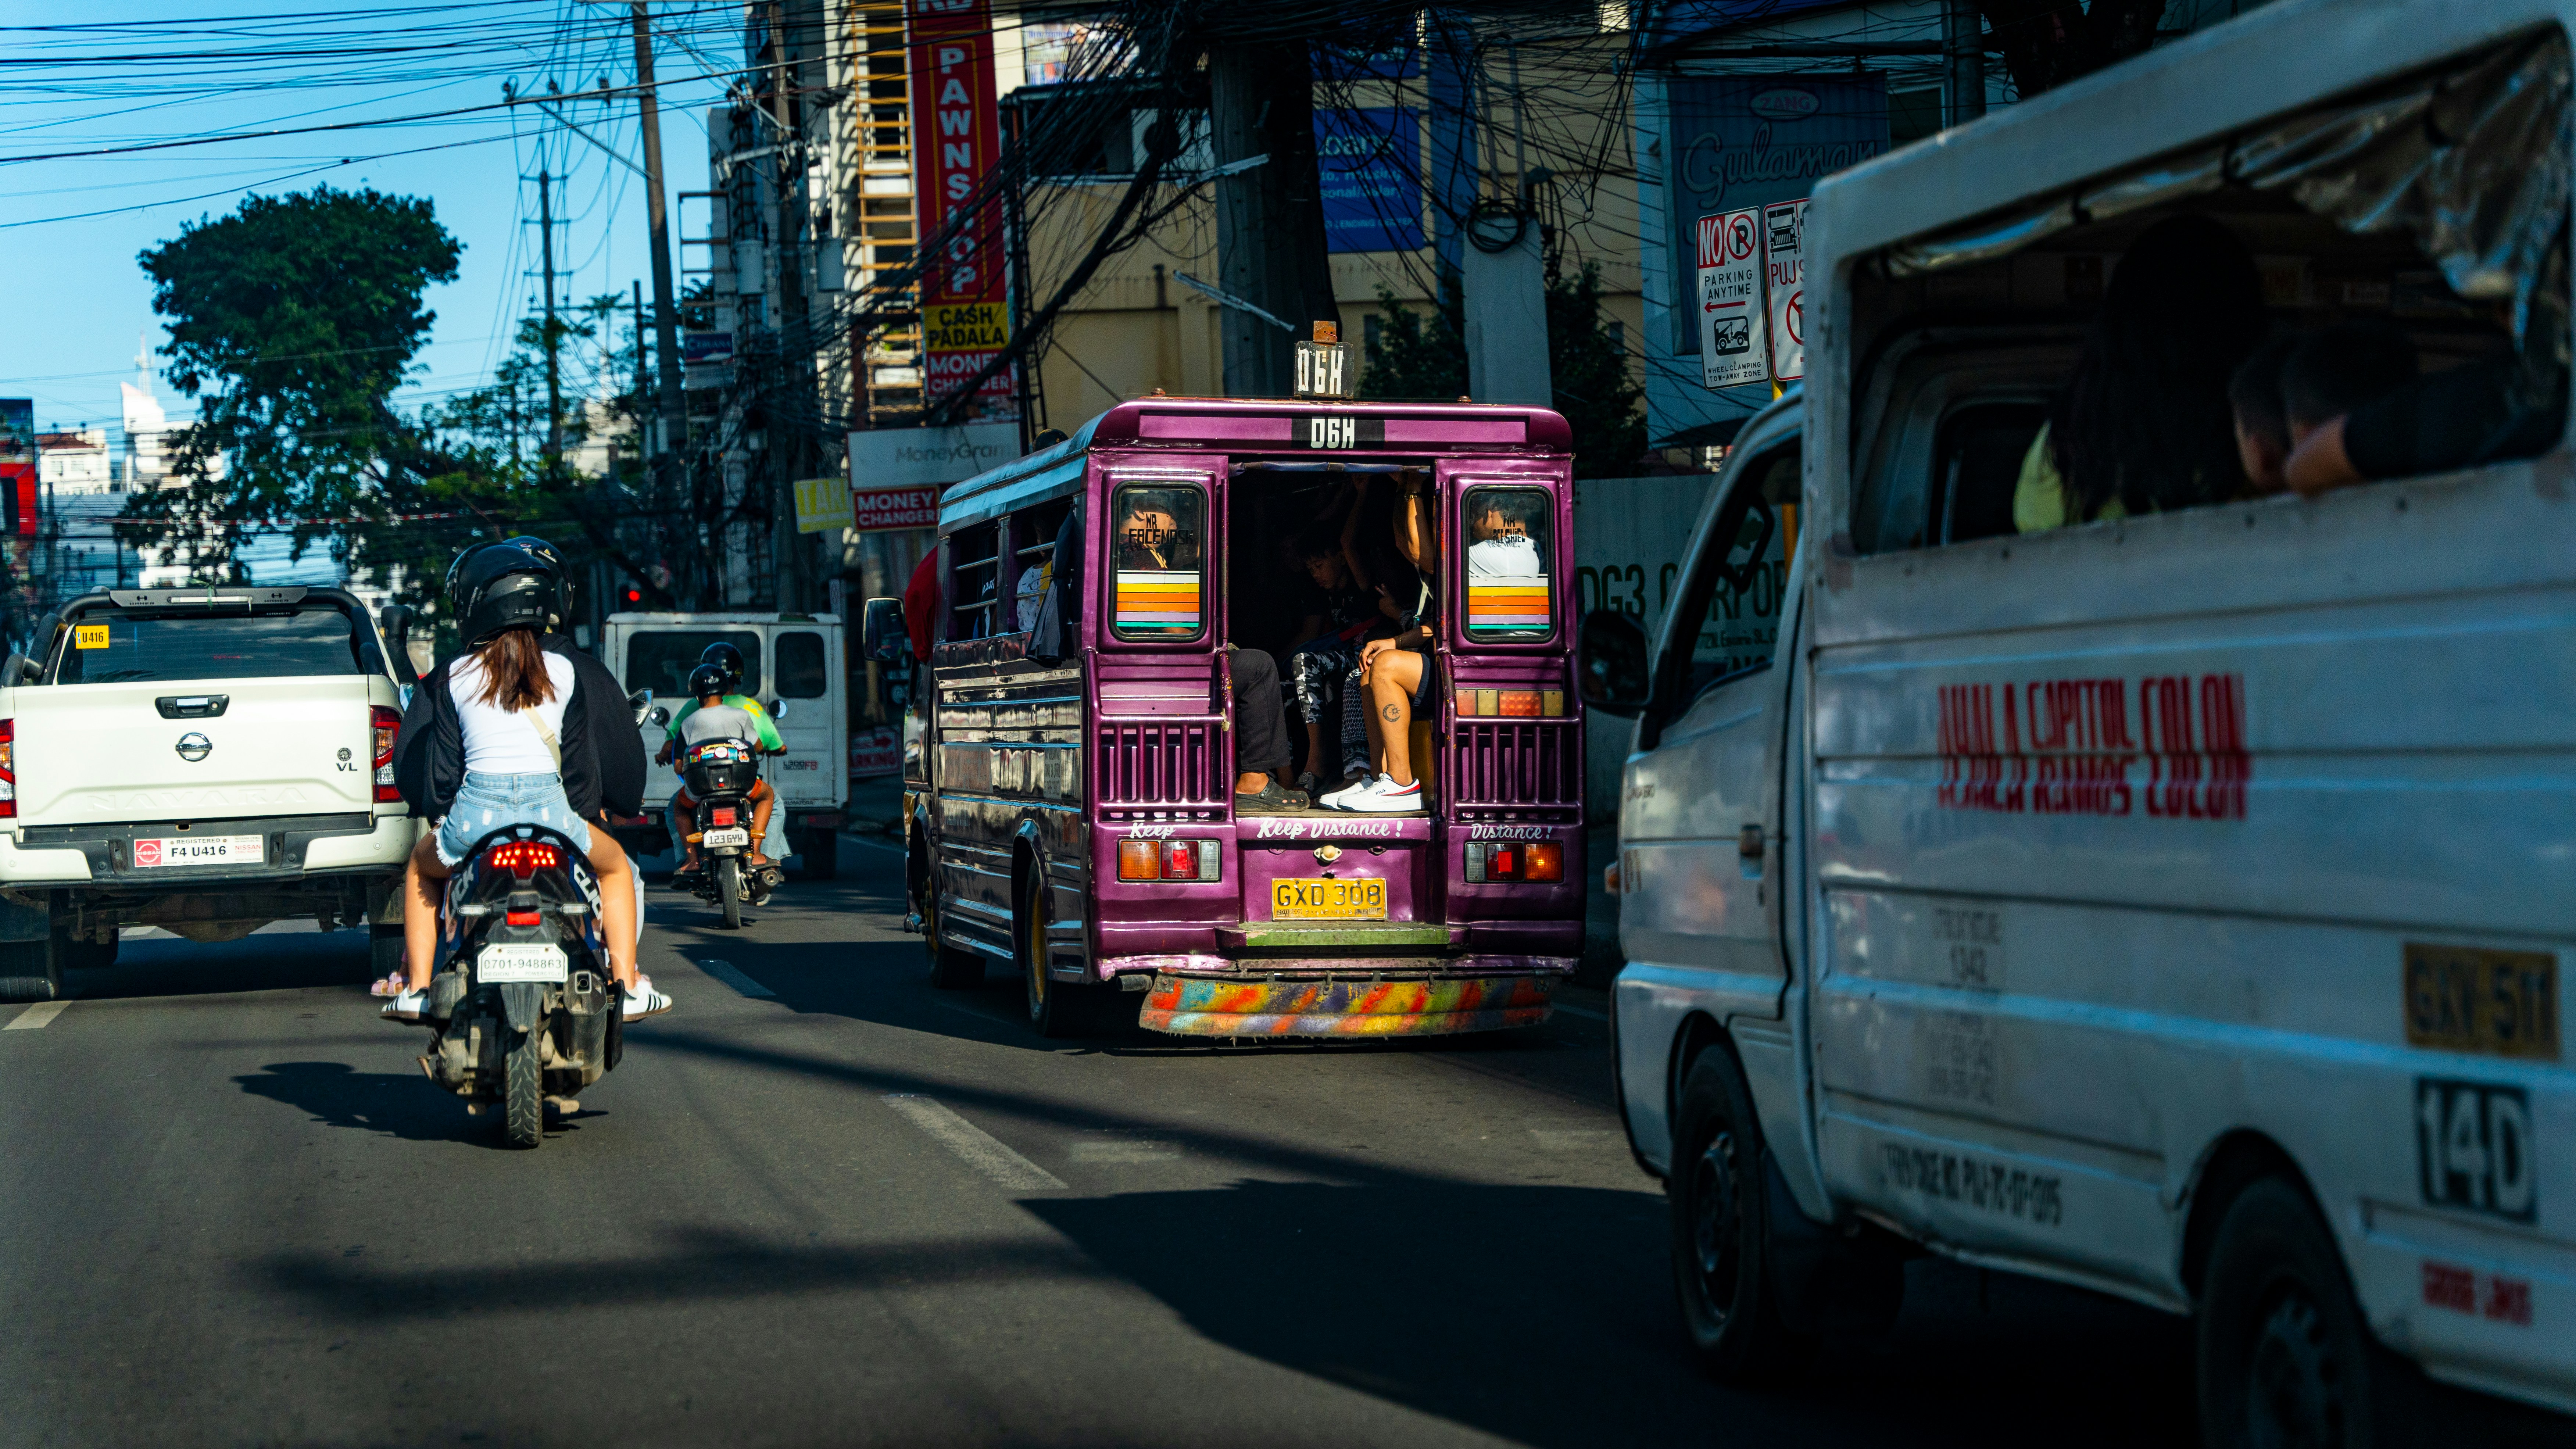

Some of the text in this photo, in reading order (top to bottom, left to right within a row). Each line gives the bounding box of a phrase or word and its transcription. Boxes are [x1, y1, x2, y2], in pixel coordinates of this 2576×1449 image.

[1760, 96, 1811, 111] ZANG
[1699, 218, 1723, 266] NO
[1704, 269, 1753, 287] PARKING
[1707, 283, 1751, 300] ANYTIME
[940, 307, 993, 326] CASH
[927, 327, 1005, 347] PADALA
[929, 353, 1000, 375] MONE
[1709, 369, 1762, 382] TOW-AWAY ZONE
[857, 491, 934, 512] MONEY
[858, 509, 935, 526] CHANGER
[1128, 528, 1194, 544] FACEMASK
[336, 762, 358, 772] VL
[87, 788, 307, 811] NAVARA
[1129, 822, 1176, 840] Keep
[1256, 820, 1307, 839] Keep
[709, 835, 725, 845] 123
[171, 847, 187, 857] F4
[1277, 883, 1380, 906] GXD 308
[484, 959, 562, 969] 0701-948863
[2420, 1081, 2531, 1213] 14D
